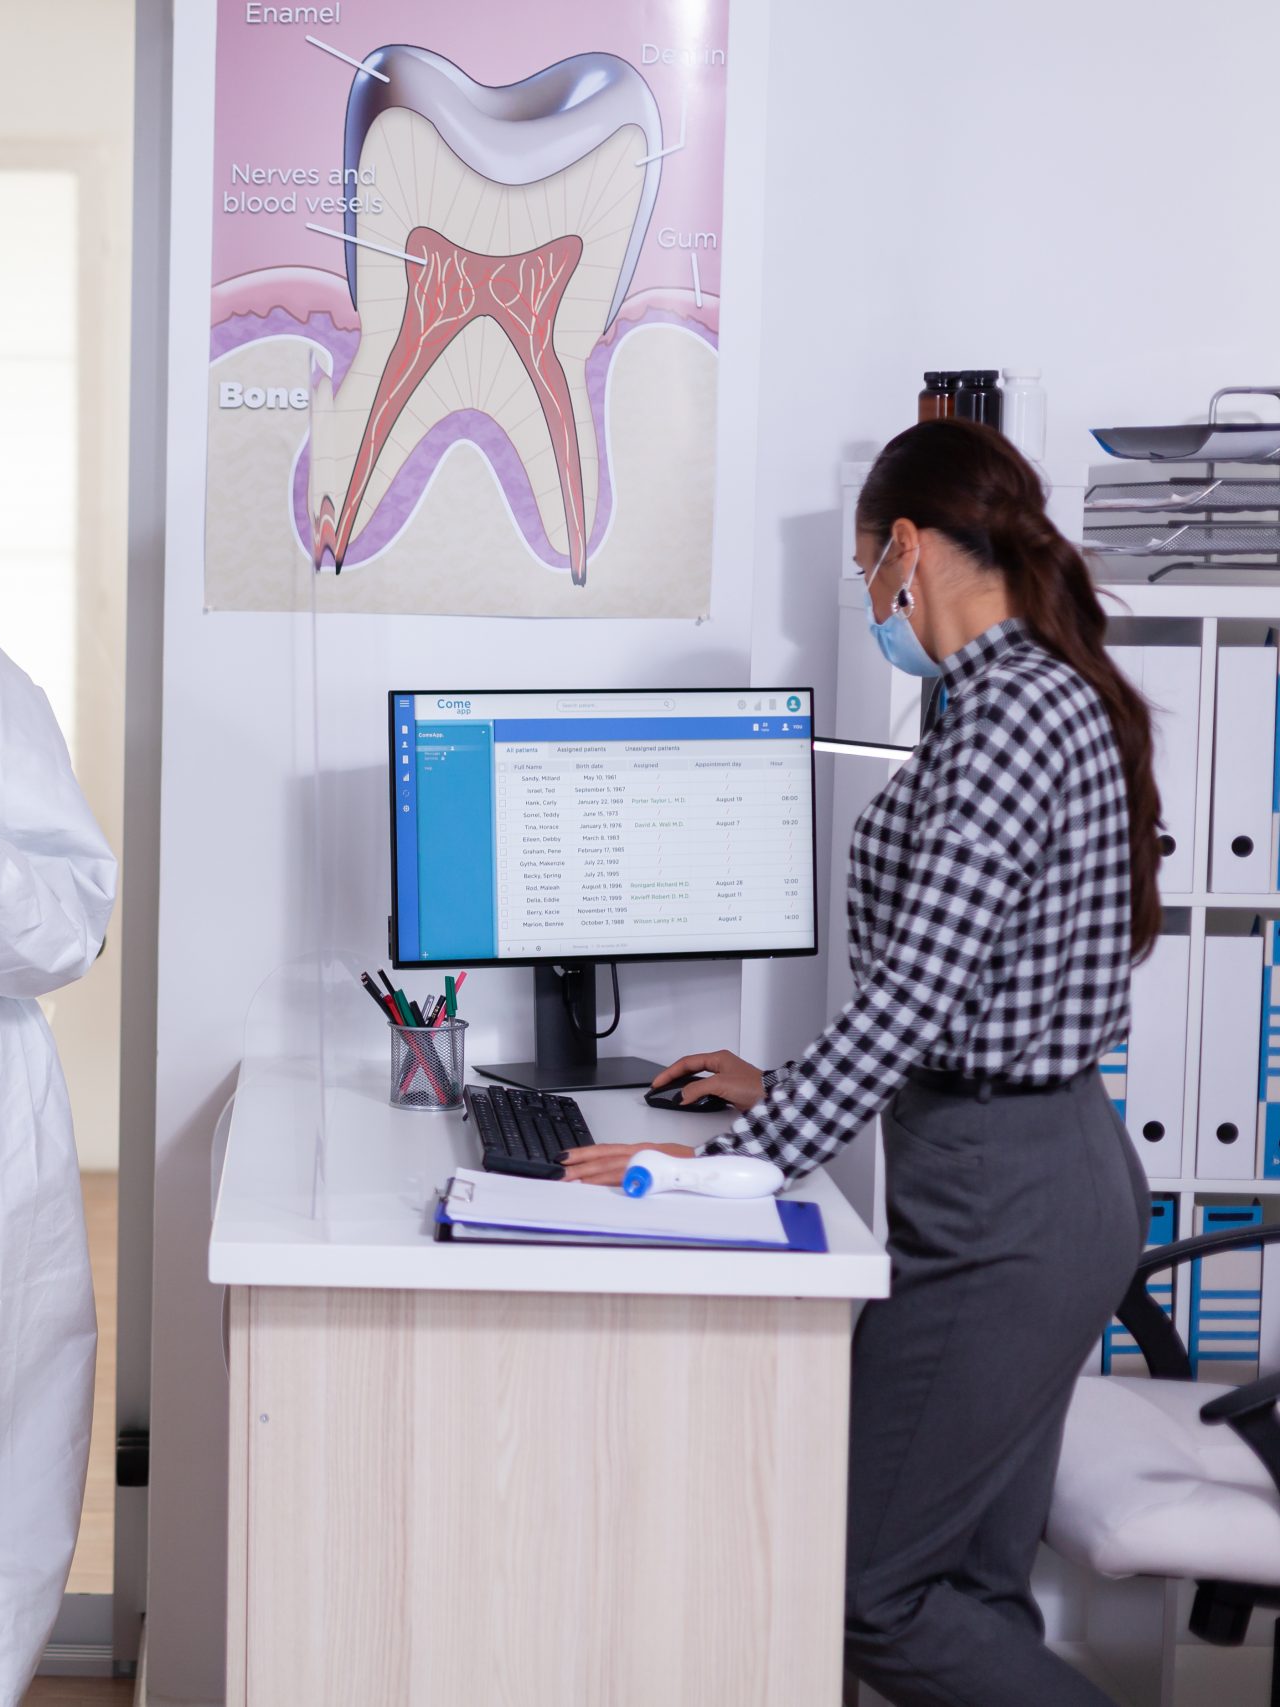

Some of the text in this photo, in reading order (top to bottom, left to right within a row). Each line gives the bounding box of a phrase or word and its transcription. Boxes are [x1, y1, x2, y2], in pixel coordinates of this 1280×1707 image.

[246, 1, 340, 24] Enamel
[231, 163, 376, 186] Nerves and
[222, 190, 384, 214] blood vesels
[657, 227, 718, 250] Gum
[219, 382, 310, 410] Bone
[437, 699, 471, 709] Come
